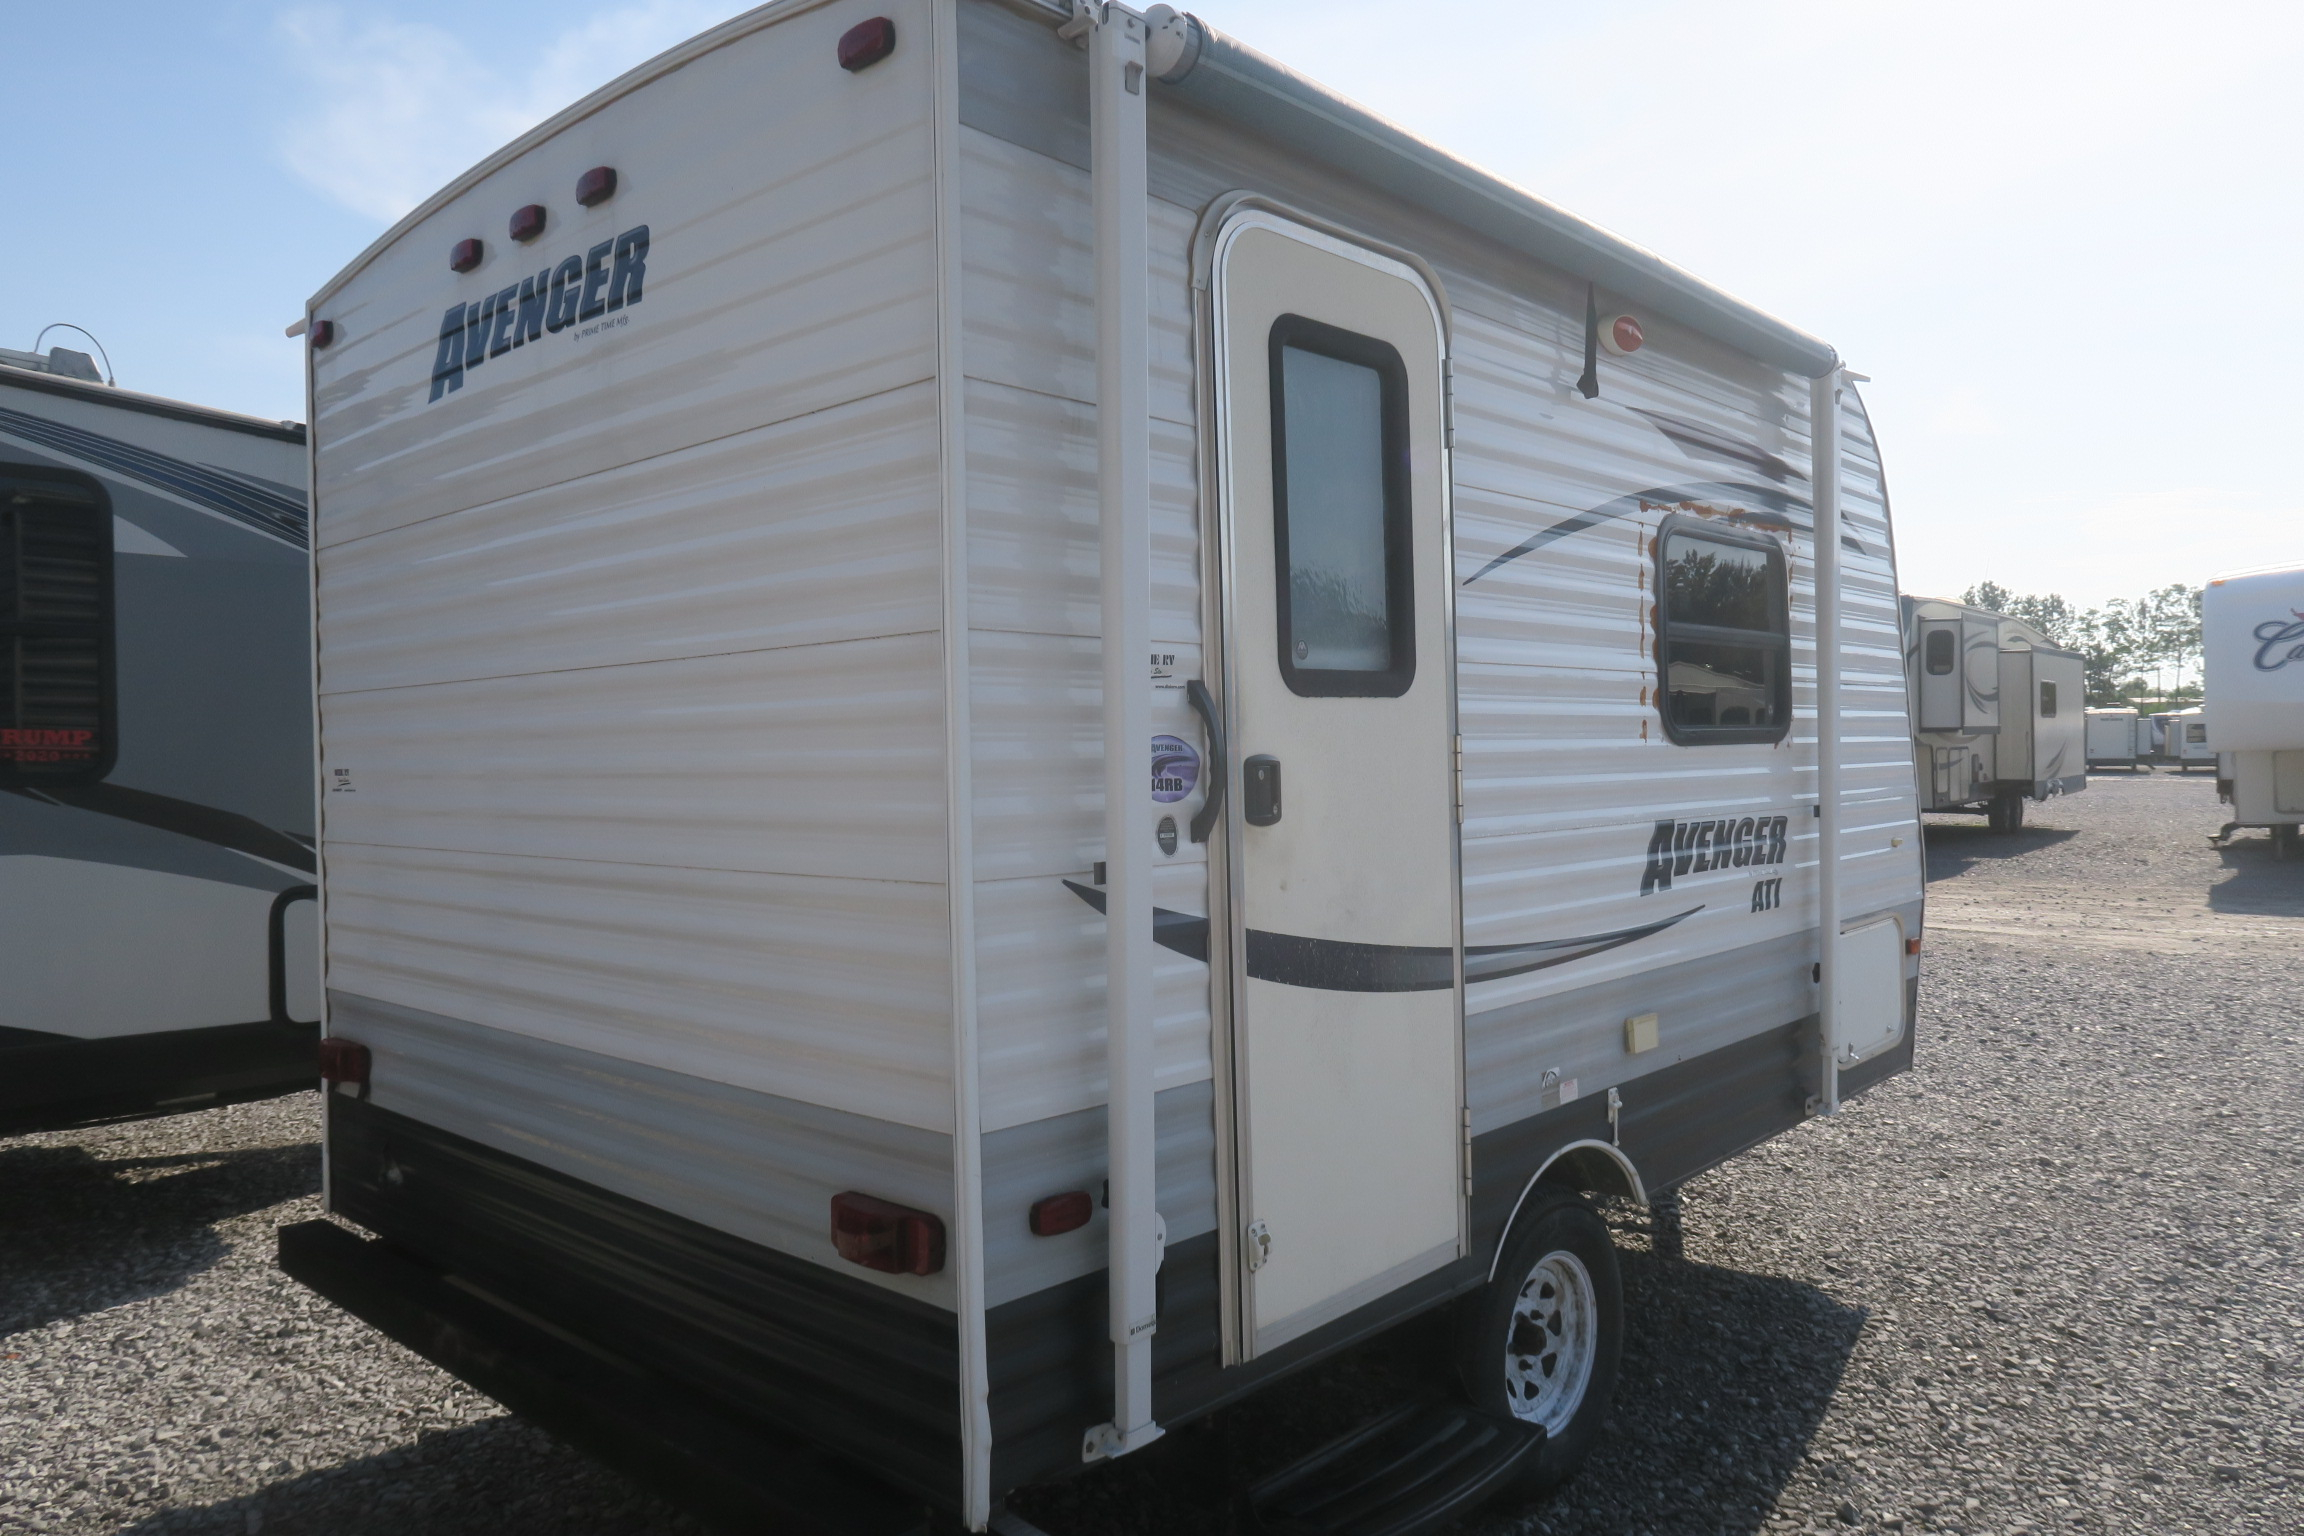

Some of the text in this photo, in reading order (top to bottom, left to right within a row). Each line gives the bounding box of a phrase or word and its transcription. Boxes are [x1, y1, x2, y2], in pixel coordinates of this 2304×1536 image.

[428, 224, 650, 404] AVENGER
[581, 323, 600, 338] PRIME
[601, 318, 616, 332] TIME
[1162, 654, 1175, 666] RV
[0, 728, 94, 746] RUMP
[15, 749, 60, 762] 2020
[1640, 815, 1788, 897] AVENGER
